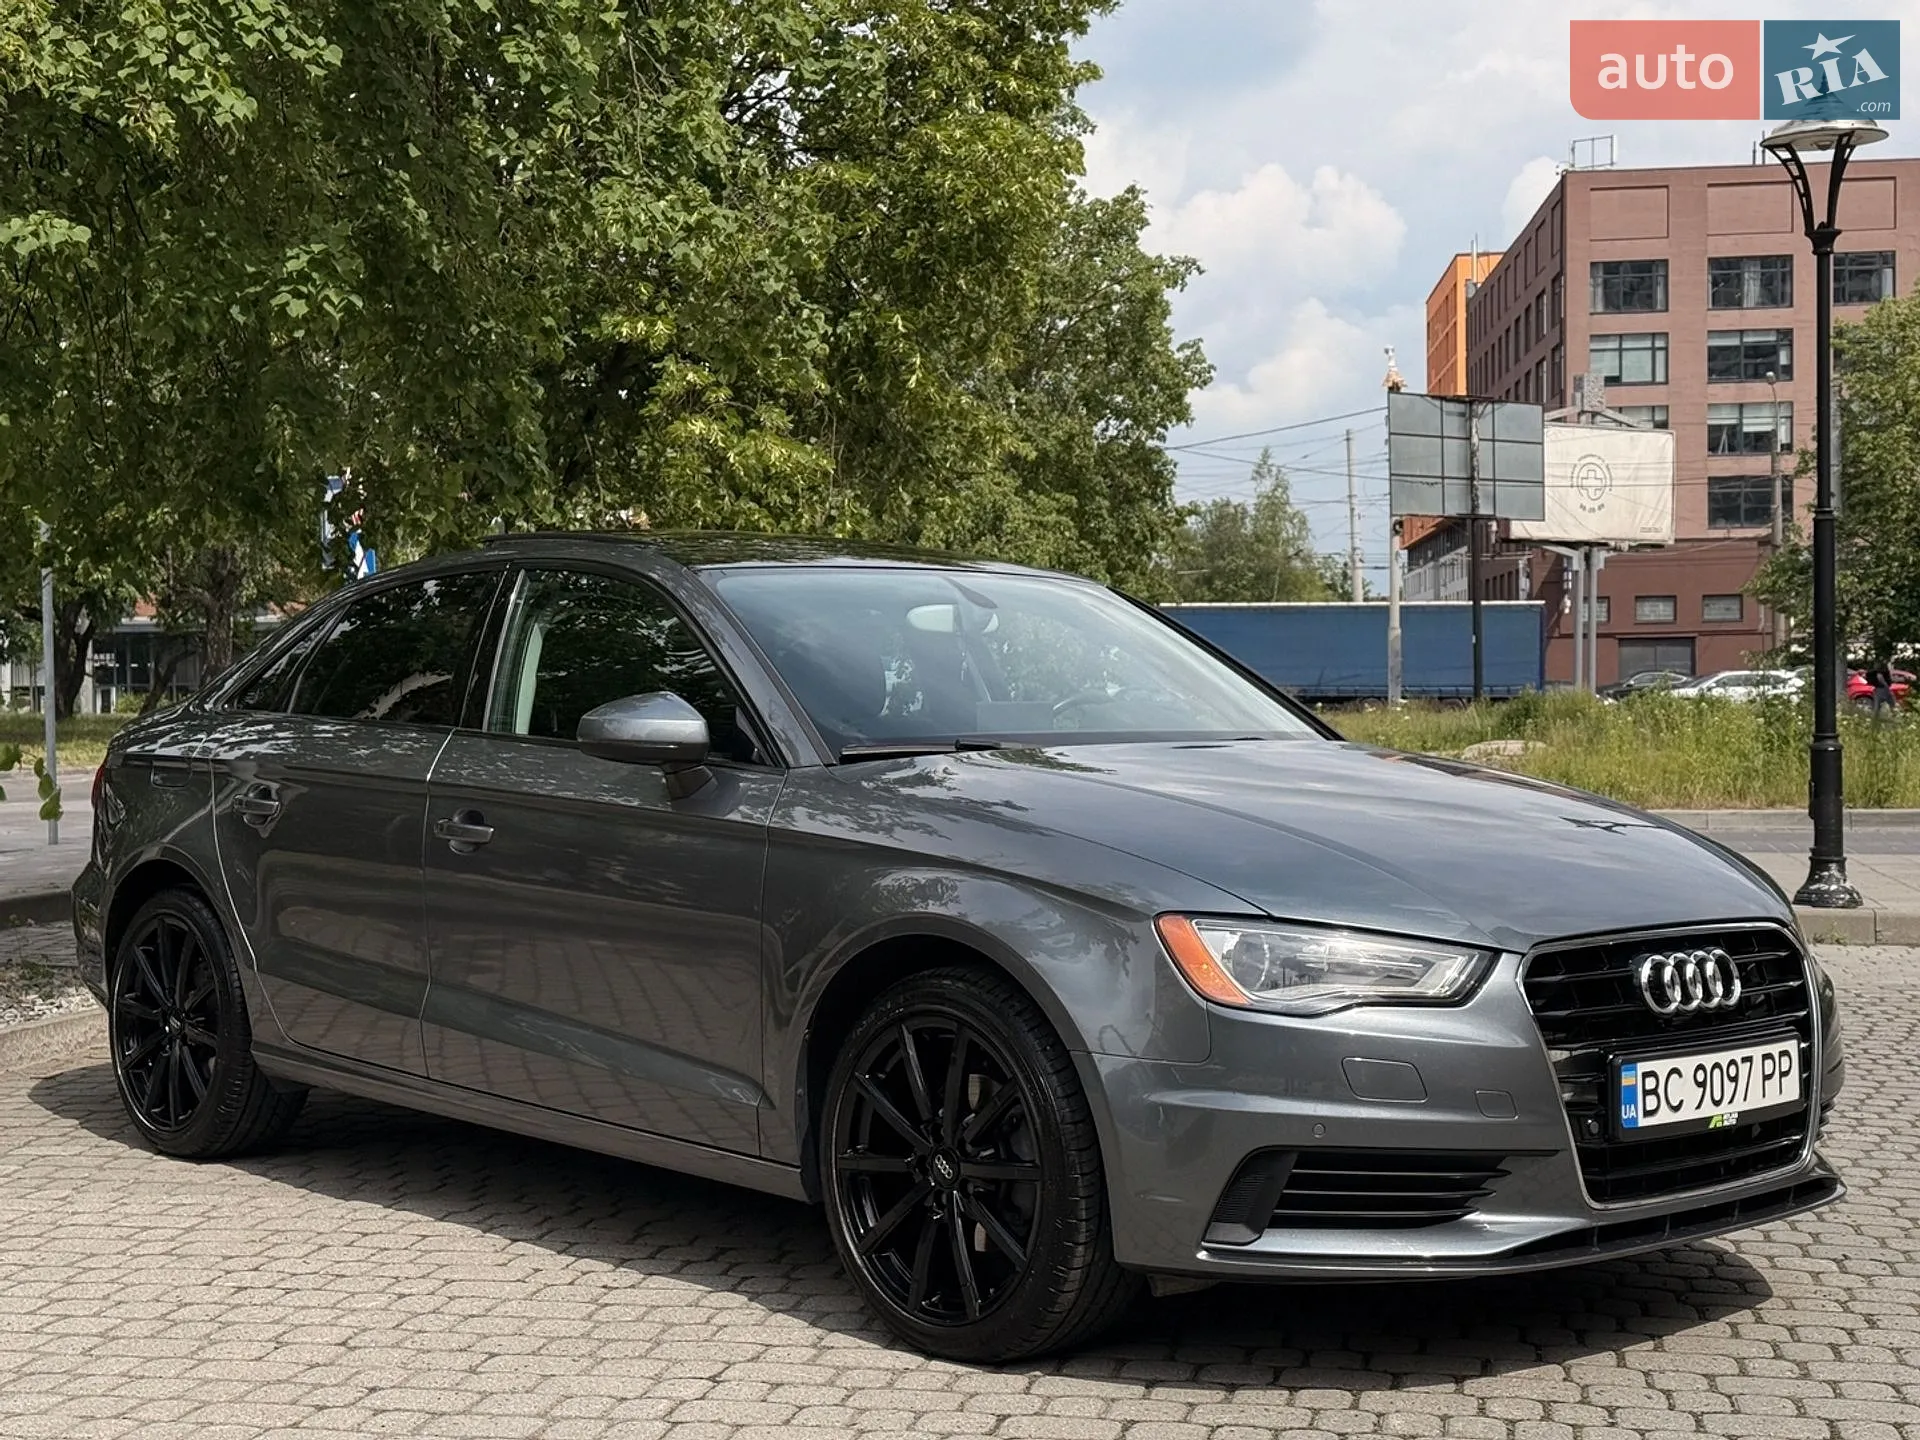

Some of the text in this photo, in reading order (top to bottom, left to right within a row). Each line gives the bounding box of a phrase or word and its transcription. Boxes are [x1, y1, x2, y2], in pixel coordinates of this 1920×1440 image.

[1641, 1049, 1792, 1118] BC 9097 PP
[1622, 1104, 1636, 1119] UA
